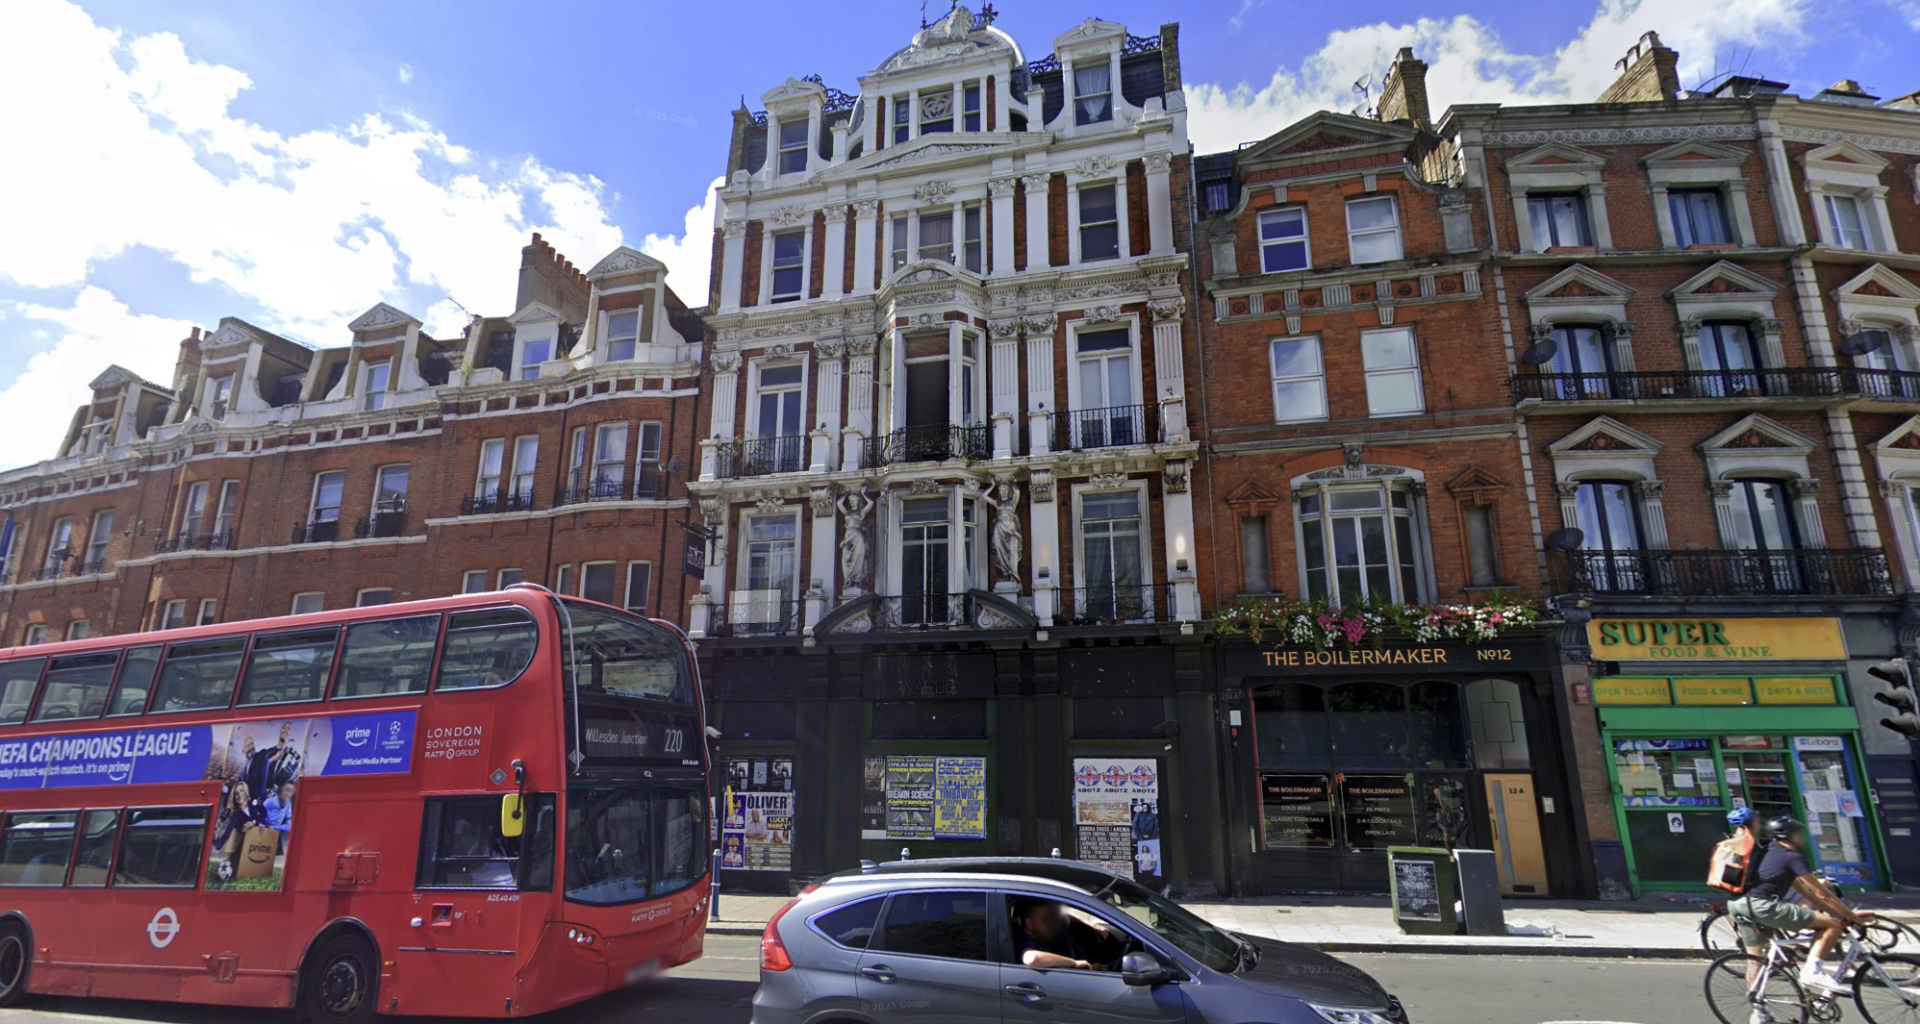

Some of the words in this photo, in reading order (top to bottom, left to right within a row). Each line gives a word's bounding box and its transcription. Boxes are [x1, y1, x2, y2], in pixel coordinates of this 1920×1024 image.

[1600, 620, 1731, 646] SUPER
[1262, 651, 1299, 667] THE
[1304, 648, 1448, 666] BOILERMAKER
[1649, 646, 1698, 658] FOOD
[1704, 646, 1718, 657] &
[1723, 646, 1772, 658] WINE
[1596, 687, 1621, 696] OPEN
[1623, 687, 1643, 696] TILL
[1645, 687, 1668, 696] LATE
[1682, 687, 1708, 696] FOOD
[1720, 687, 1743, 696] WINE
[1767, 687, 1793, 696] DAYS
[344, 727, 371, 741] prime
[427, 726, 482, 739] LONDON
[425, 739, 481, 749] SOVEREIGN
[585, 728, 619, 743] Willesden
[620, 730, 647, 745] Junction
[664, 729, 683, 752] 220
[1807, 738, 1838, 746] Lebara
[30, 736, 123, 763] CHAMPIONS
[123, 732, 192, 758] LEAGUE
[424, 750, 444, 759] RATP
[454, 748, 480, 758] GROUP
[341, 758, 362, 767] Official
[363, 757, 379, 766] Media
[380, 756, 402, 765] Partner
[938, 759, 982, 767] HOUSE
[61, 763, 84, 775] match.
[86, 762, 97, 774] It's
[98, 764, 107, 773] on
[107, 761, 131, 775] prime
[937, 767, 983, 775] DELIGHT
[911, 790, 934, 799] SCIENCE
[939, 790, 980, 800] TIMBAWOLF
[747, 796, 788, 809] OLIVER
[1079, 809, 1130, 823] MUSIC
[248, 842, 272, 855] prime
[631, 913, 648, 923] RATP
[654, 907, 672, 918] GROUP
